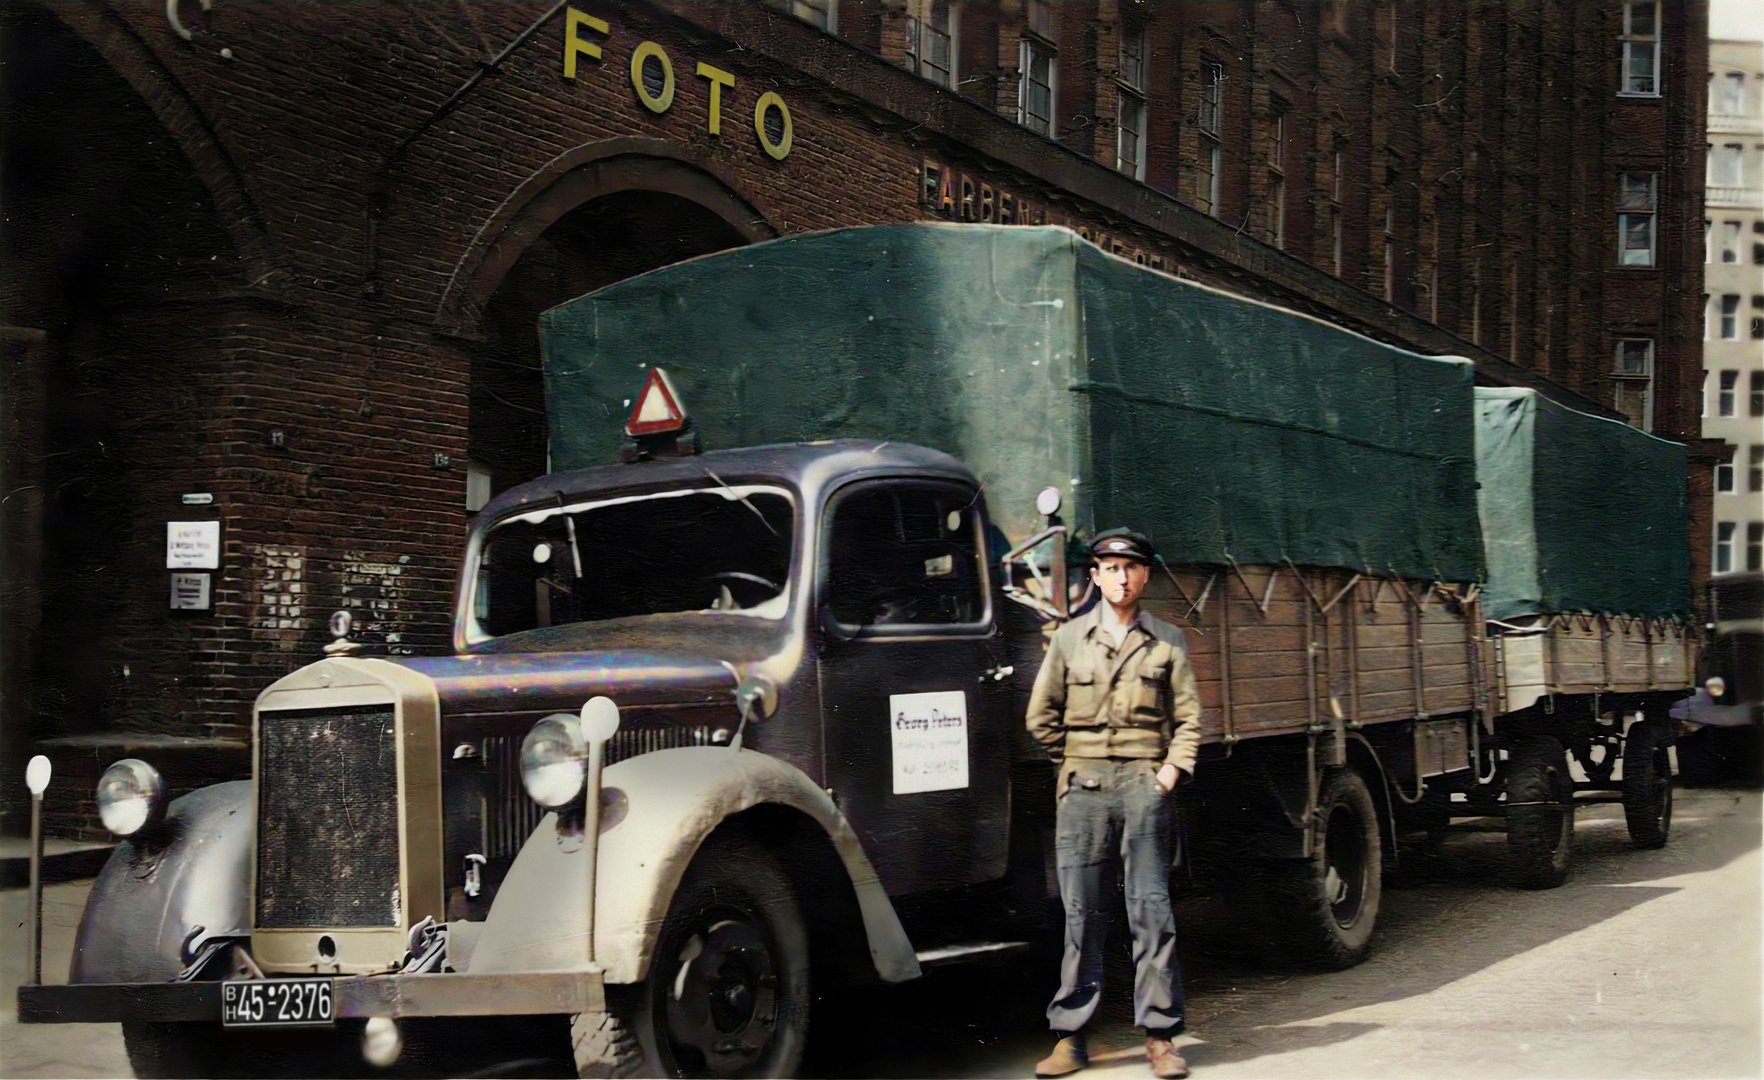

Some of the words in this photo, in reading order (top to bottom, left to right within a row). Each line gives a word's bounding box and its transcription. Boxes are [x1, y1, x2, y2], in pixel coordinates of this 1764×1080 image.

[563, 7, 794, 160] FOTO
[923, 157, 1030, 226] FARBEN
[237, 983, 331, 1020] 45-2376
